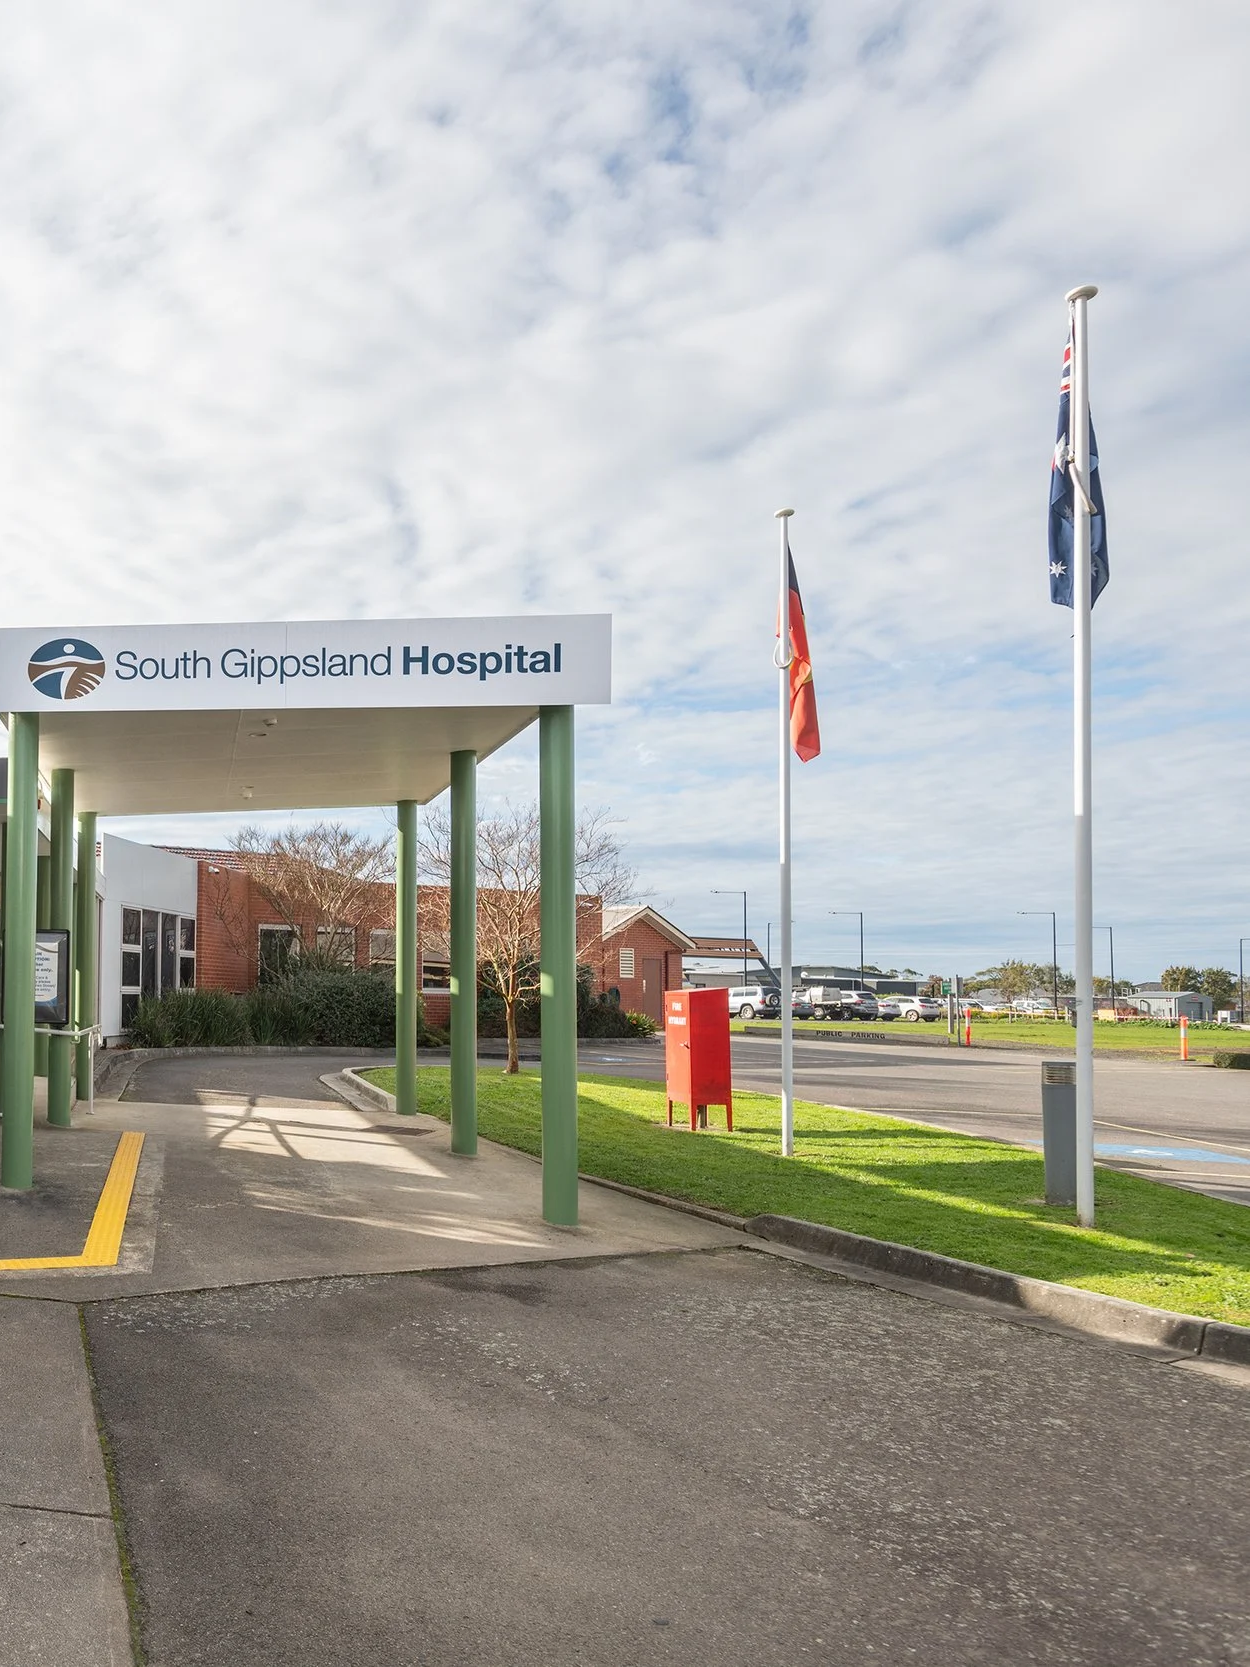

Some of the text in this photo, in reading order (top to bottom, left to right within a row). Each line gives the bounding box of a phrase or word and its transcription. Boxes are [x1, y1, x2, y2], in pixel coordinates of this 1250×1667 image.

[115, 643, 562, 684] South Gippsland Hospital
